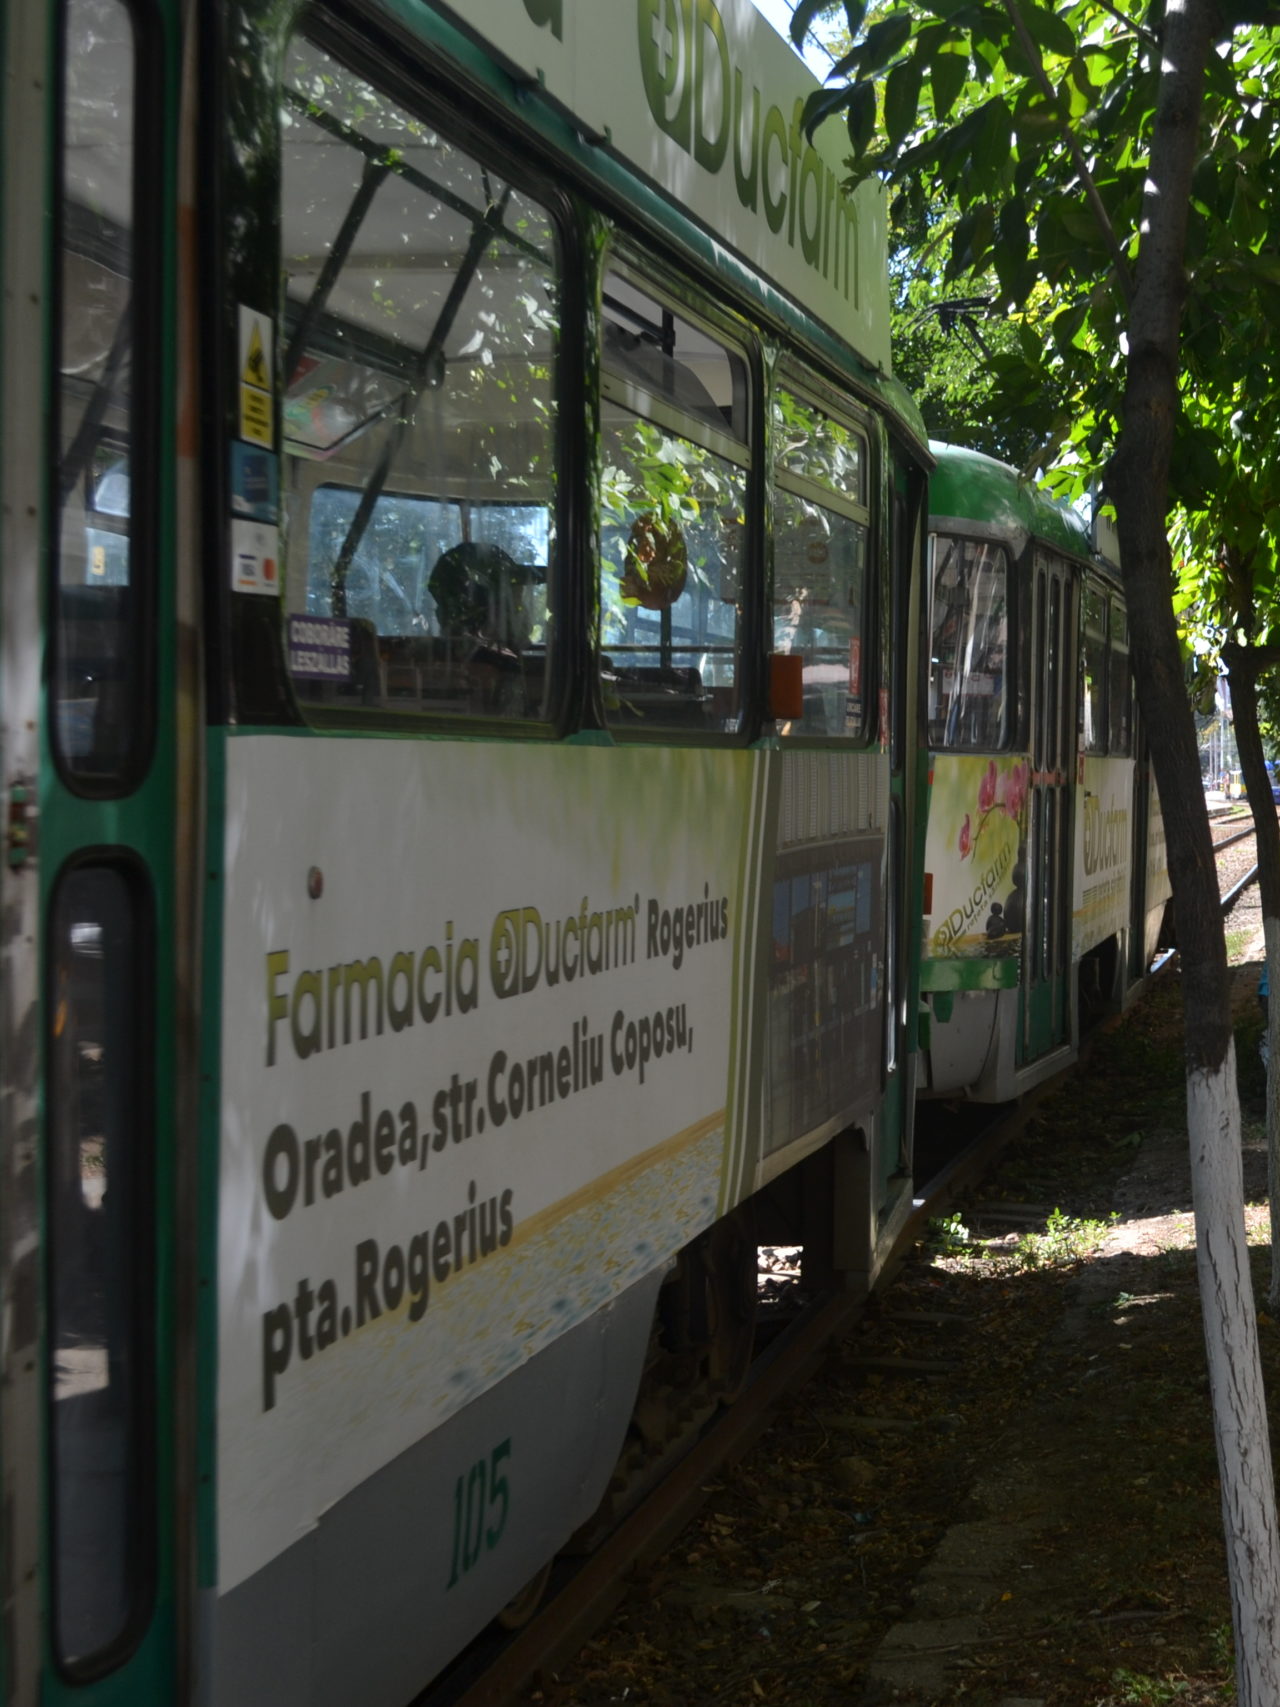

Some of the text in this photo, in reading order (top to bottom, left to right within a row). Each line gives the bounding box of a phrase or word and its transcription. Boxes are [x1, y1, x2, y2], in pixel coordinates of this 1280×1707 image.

[265, 921, 480, 1068] Farmacia
[646, 882, 729, 970] Rogerius
[611, 1003, 694, 1085] Coposu,
[262, 1180, 514, 1413] pta.Rogerius
[447, 1436, 512, 1590] 105
